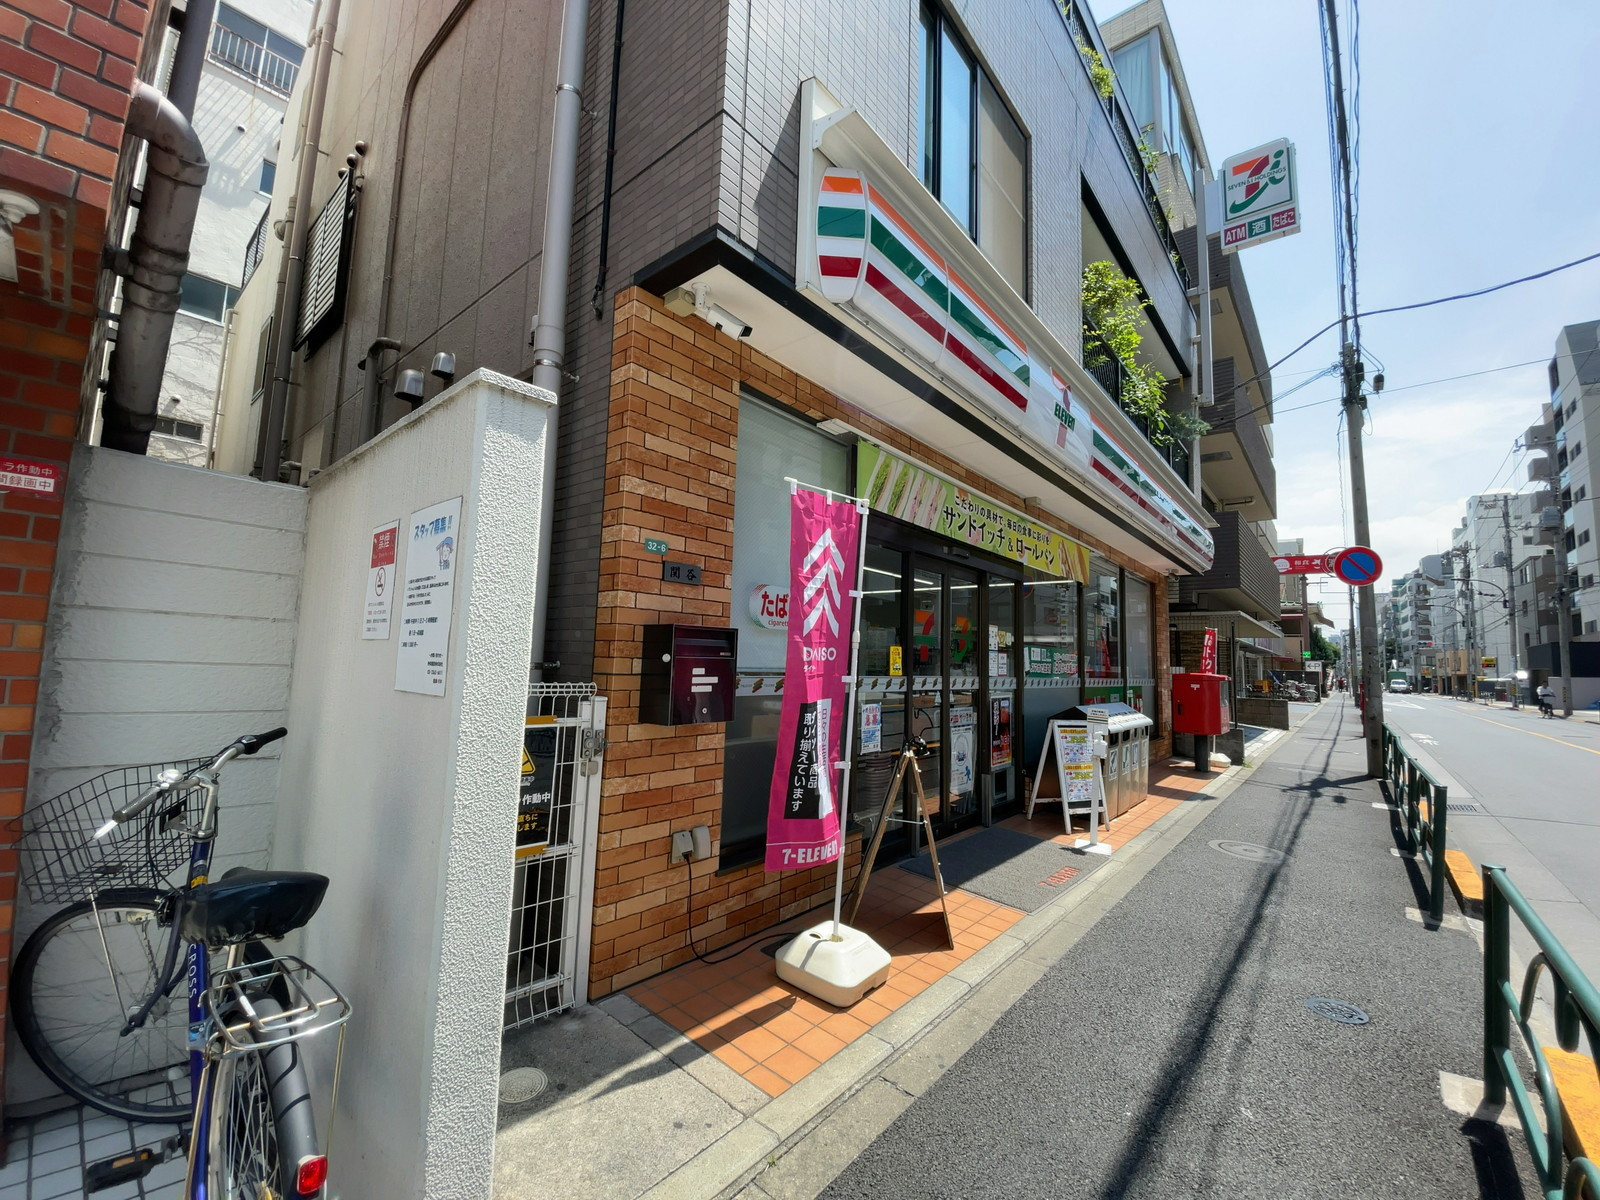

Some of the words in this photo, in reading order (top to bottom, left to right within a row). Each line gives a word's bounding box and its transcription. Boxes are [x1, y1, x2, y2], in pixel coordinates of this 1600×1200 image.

[1252, 219, 1266, 236] 酒
[1272, 211, 1294, 228] たばこ
[1225, 225, 1246, 243] ATM
[647, 541, 666, 553] 32-6
[803, 646, 837, 662] DAISO
[791, 712, 813, 812] 取り揃えています
[519, 791, 551, 806] 作動中
[188, 943, 197, 999] CROSS
